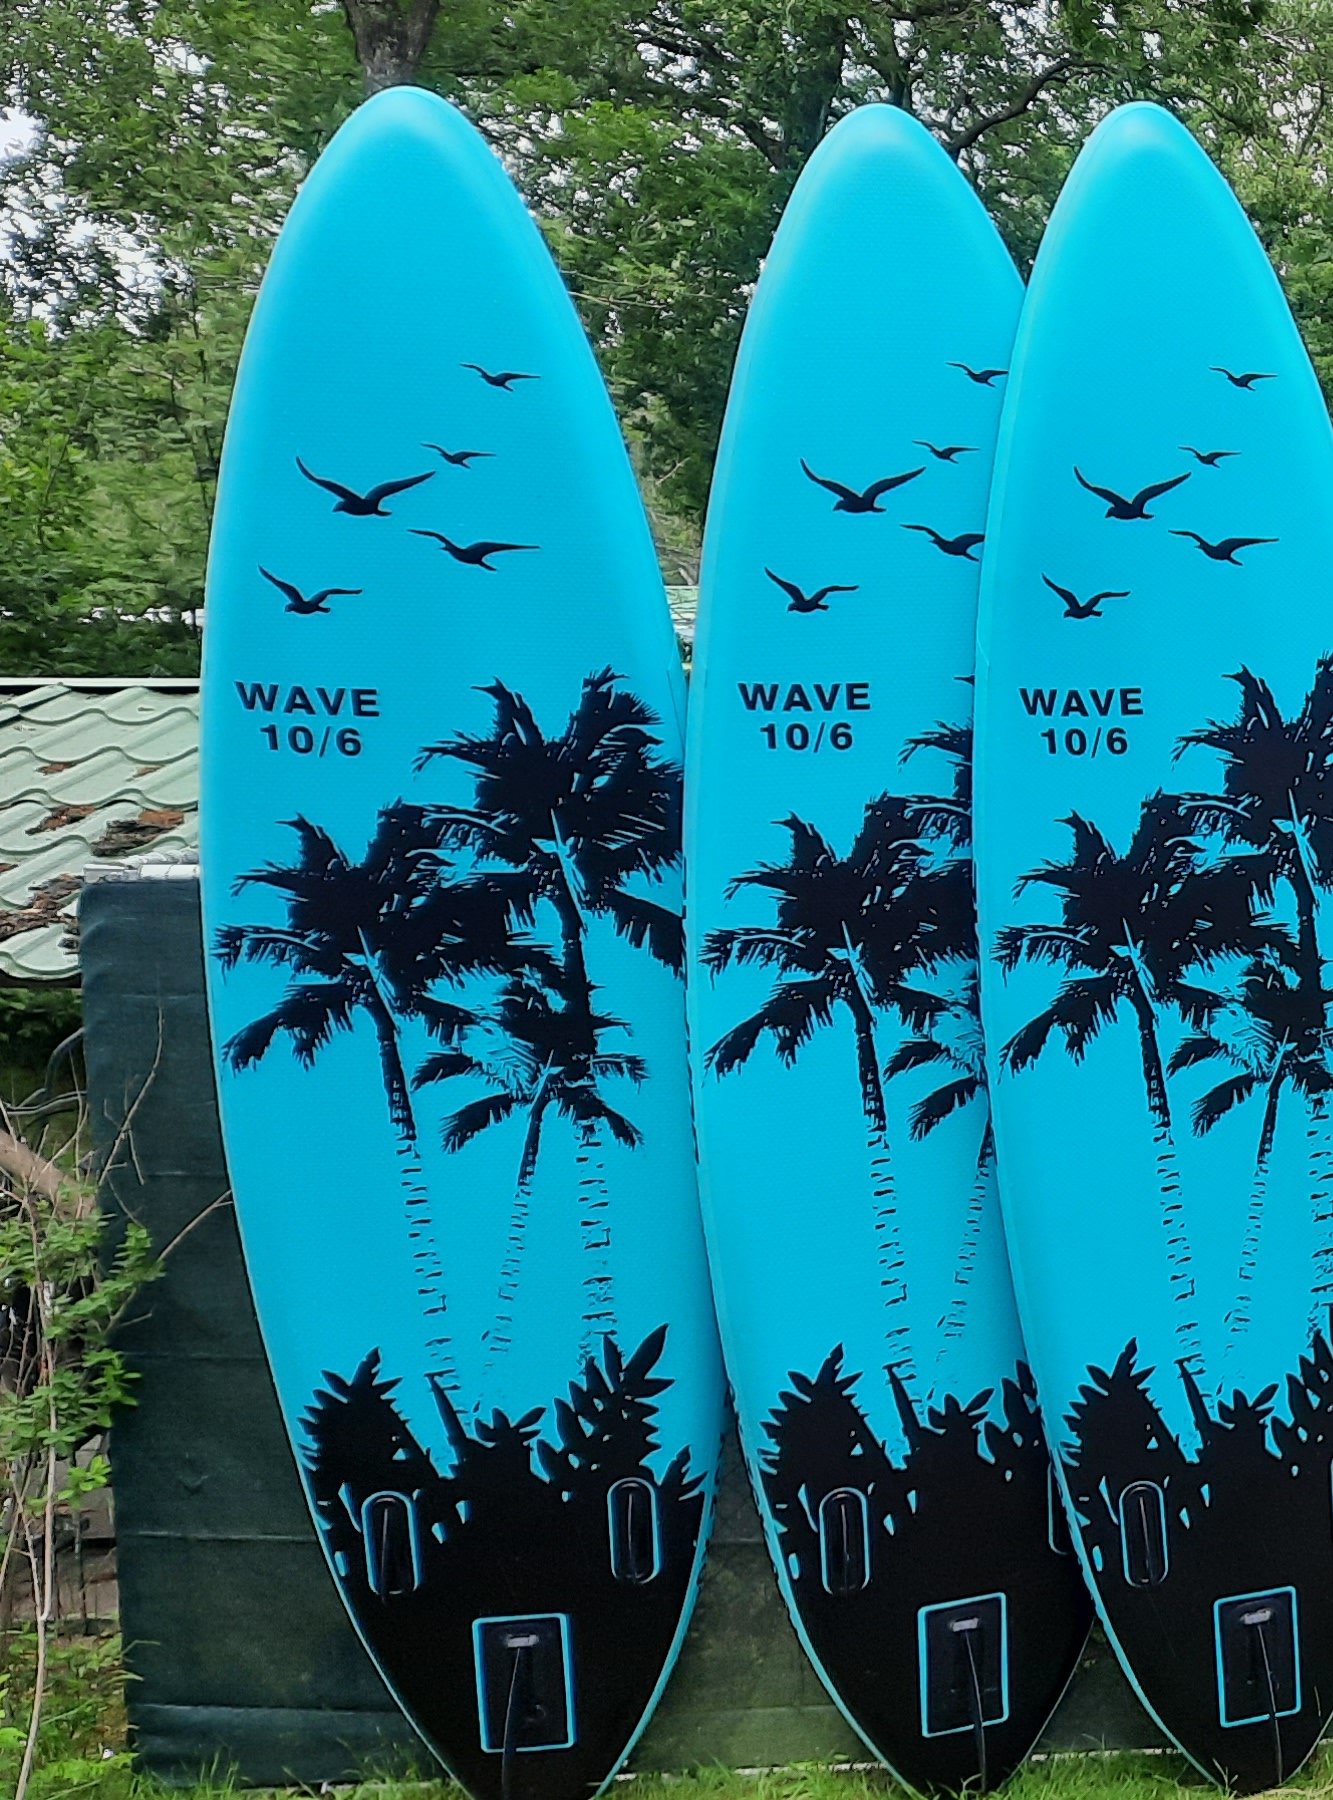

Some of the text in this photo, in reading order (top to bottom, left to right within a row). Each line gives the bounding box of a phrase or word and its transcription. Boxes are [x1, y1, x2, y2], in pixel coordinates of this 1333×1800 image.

[236, 681, 380, 717] WAVE
[738, 682, 872, 712] WAVE
[1020, 687, 1145, 717] WAVE
[261, 724, 363, 757] 10/6
[761, 722, 854, 752] 10/6
[1041, 727, 1129, 757] 10/6
